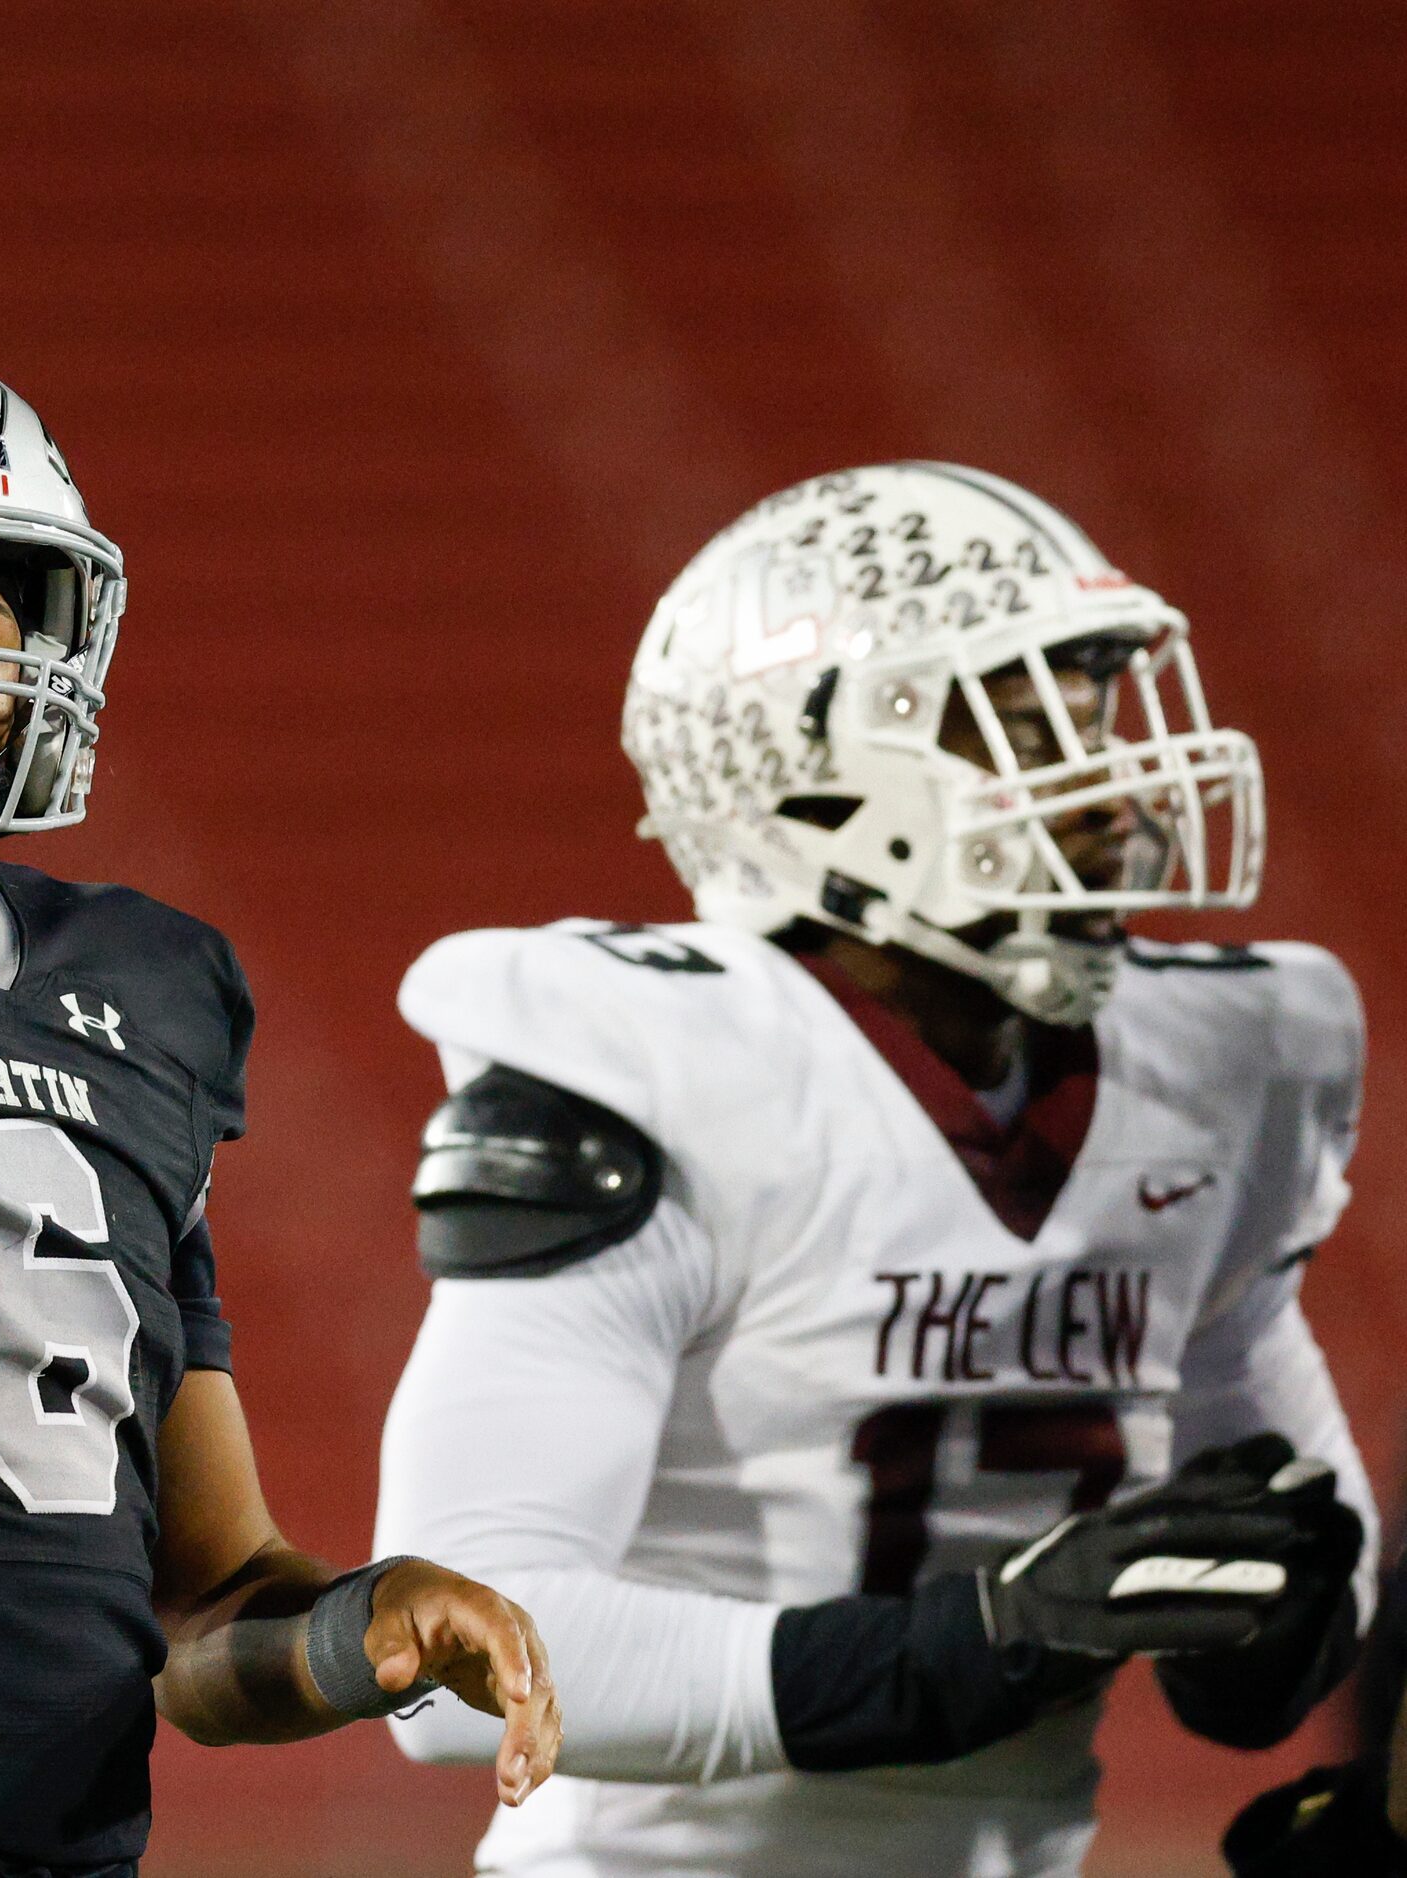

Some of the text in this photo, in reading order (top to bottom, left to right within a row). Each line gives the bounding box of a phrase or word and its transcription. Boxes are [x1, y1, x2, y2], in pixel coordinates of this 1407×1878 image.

[858, 565, 887, 600] 2
[874, 1270, 1150, 1386] THE LEW
